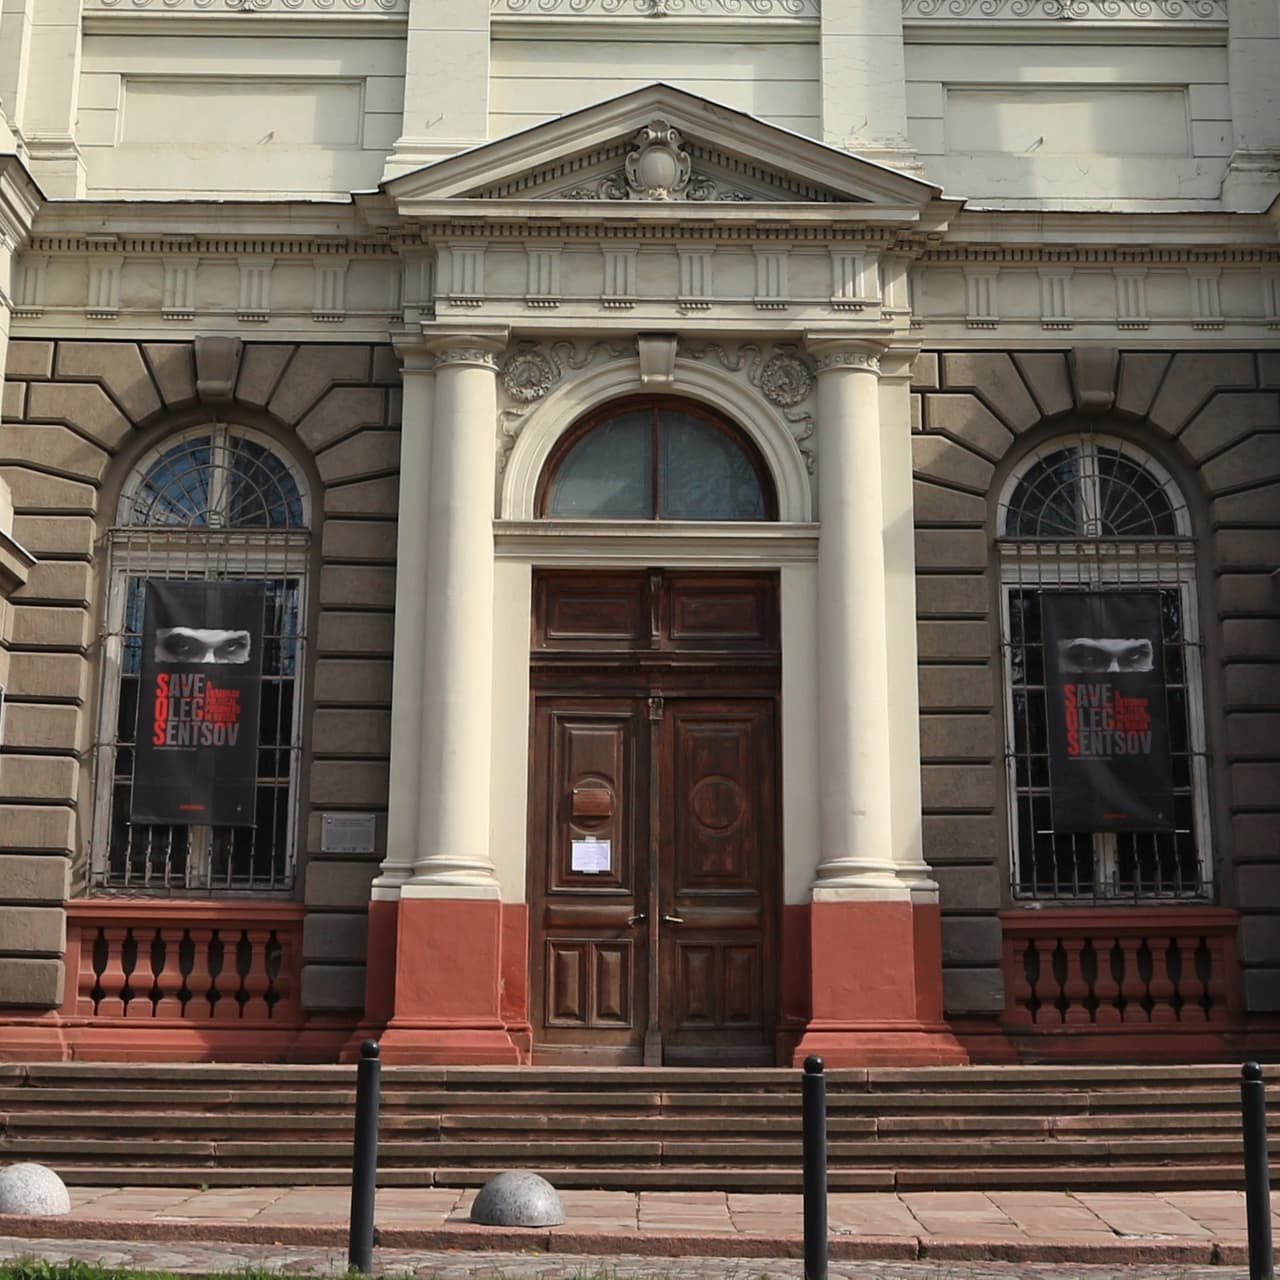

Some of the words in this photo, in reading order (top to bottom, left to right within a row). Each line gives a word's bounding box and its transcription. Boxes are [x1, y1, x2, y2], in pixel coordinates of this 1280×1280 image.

[155, 672, 205, 698] SAVE
[1063, 683, 1113, 709] SAVE
[154, 697, 205, 722] OLEG
[152, 720, 240, 747] SENTSOV
[1066, 730, 1152, 756] SENTSOV
